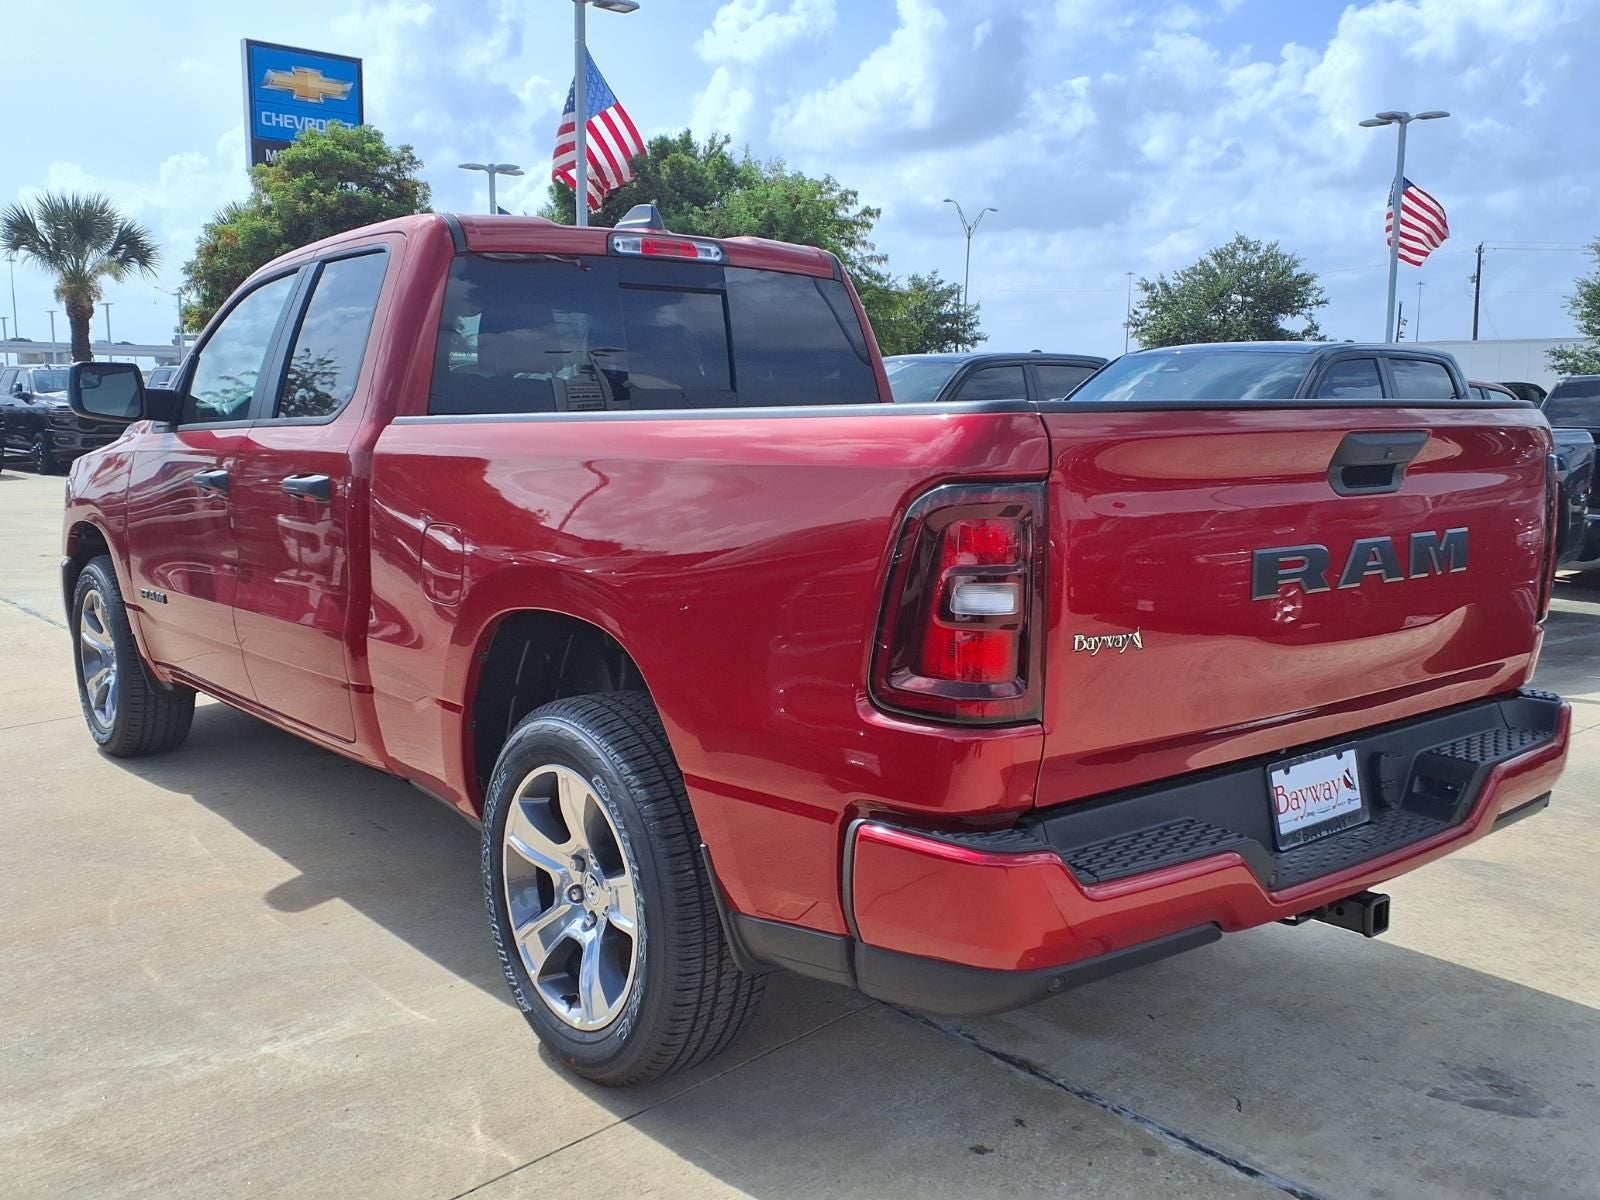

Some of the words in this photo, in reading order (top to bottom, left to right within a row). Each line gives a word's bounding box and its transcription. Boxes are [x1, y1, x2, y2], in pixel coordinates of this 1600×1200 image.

[261, 111, 356, 133] CHEVROT
[1252, 527, 1469, 600] RAM
[140, 588, 168, 604] RAM
[1073, 633, 1134, 656] Bayway
[1273, 777, 1341, 820] Bayway
